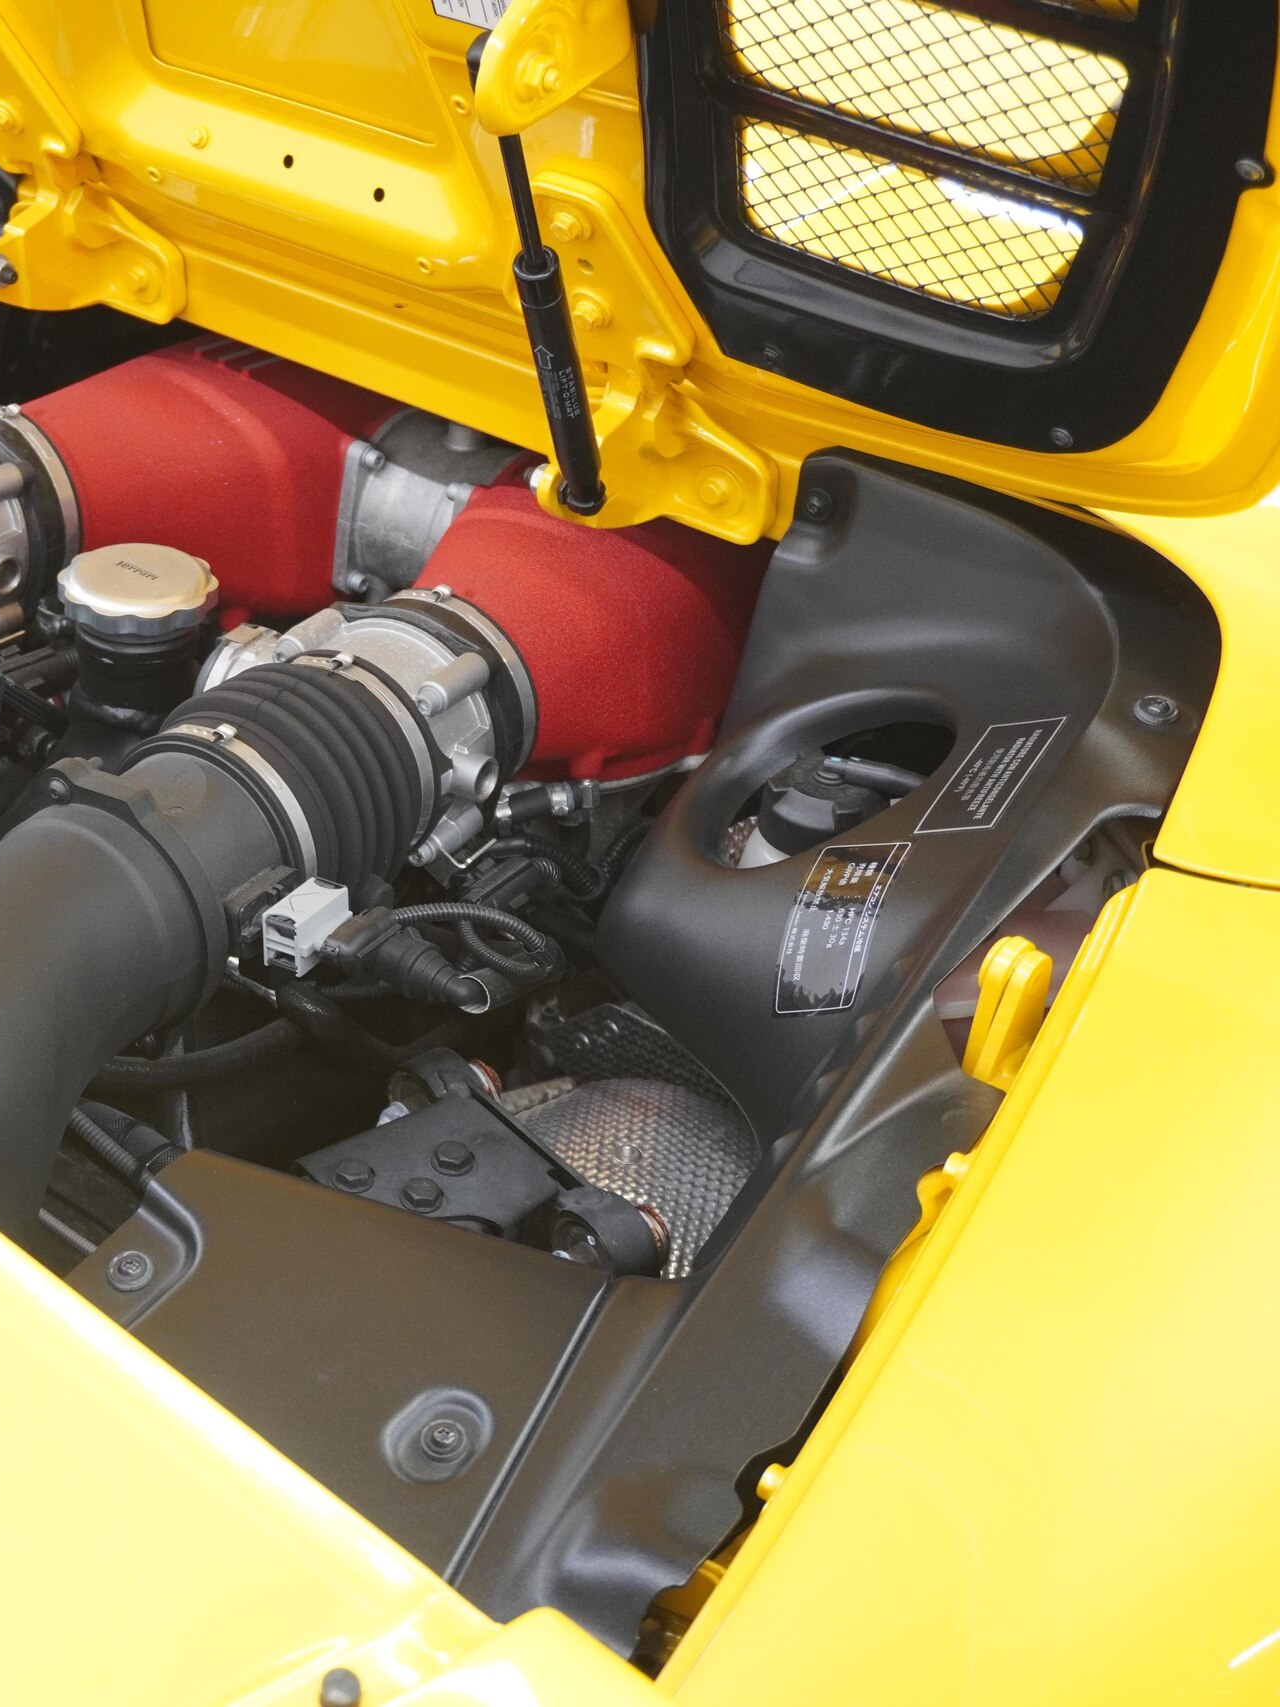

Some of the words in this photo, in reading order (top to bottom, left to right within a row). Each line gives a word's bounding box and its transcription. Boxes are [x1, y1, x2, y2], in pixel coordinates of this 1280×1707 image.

[566, 366, 581, 416] STABILUS
[116, 560, 159, 581] Ferrari
[1001, 737, 1026, 764] RADIATOR
[1016, 729, 1043, 758] RADIATORE
[991, 763, 1008, 778] WITH
[1007, 759, 1021, 770] CON
[967, 778, 996, 811] ANTIFREEZE
[973, 771, 1013, 819] ANTICONGELANTE
[835, 908, 846, 923] 630
[845, 907, 856, 925] HFC
